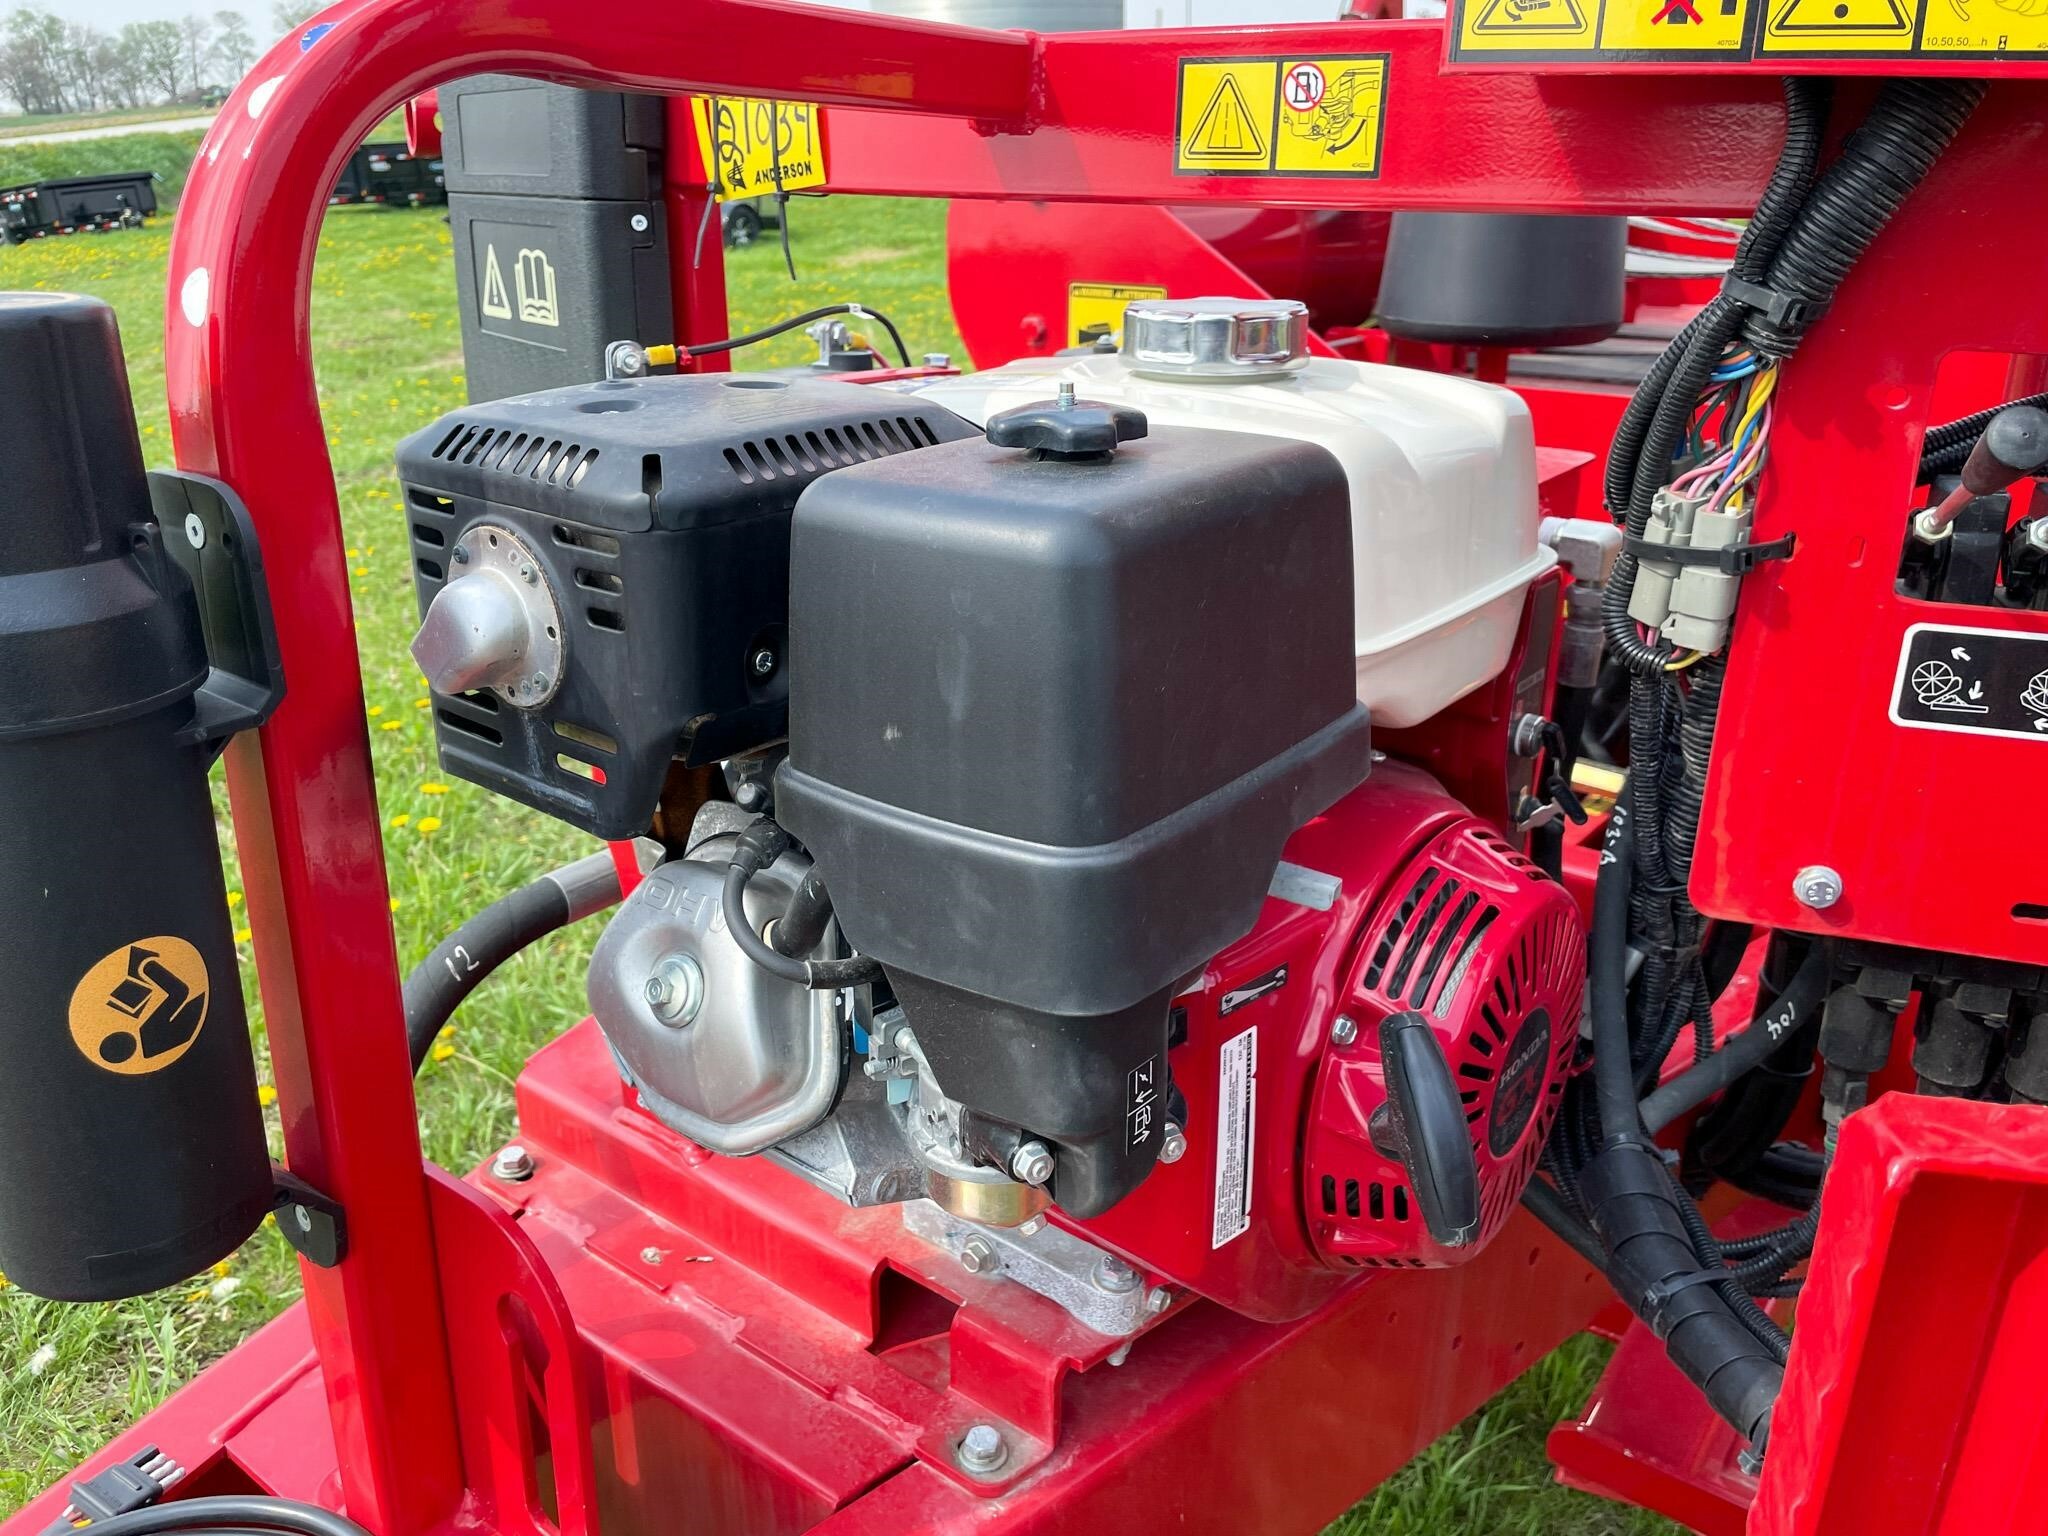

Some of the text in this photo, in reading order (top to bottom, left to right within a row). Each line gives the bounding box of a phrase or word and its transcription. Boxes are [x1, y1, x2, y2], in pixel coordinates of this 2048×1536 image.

[755, 161, 812, 184] ANDERSON
[445, 945, 480, 981] 12
[1499, 1029, 1549, 1089] HONDA
